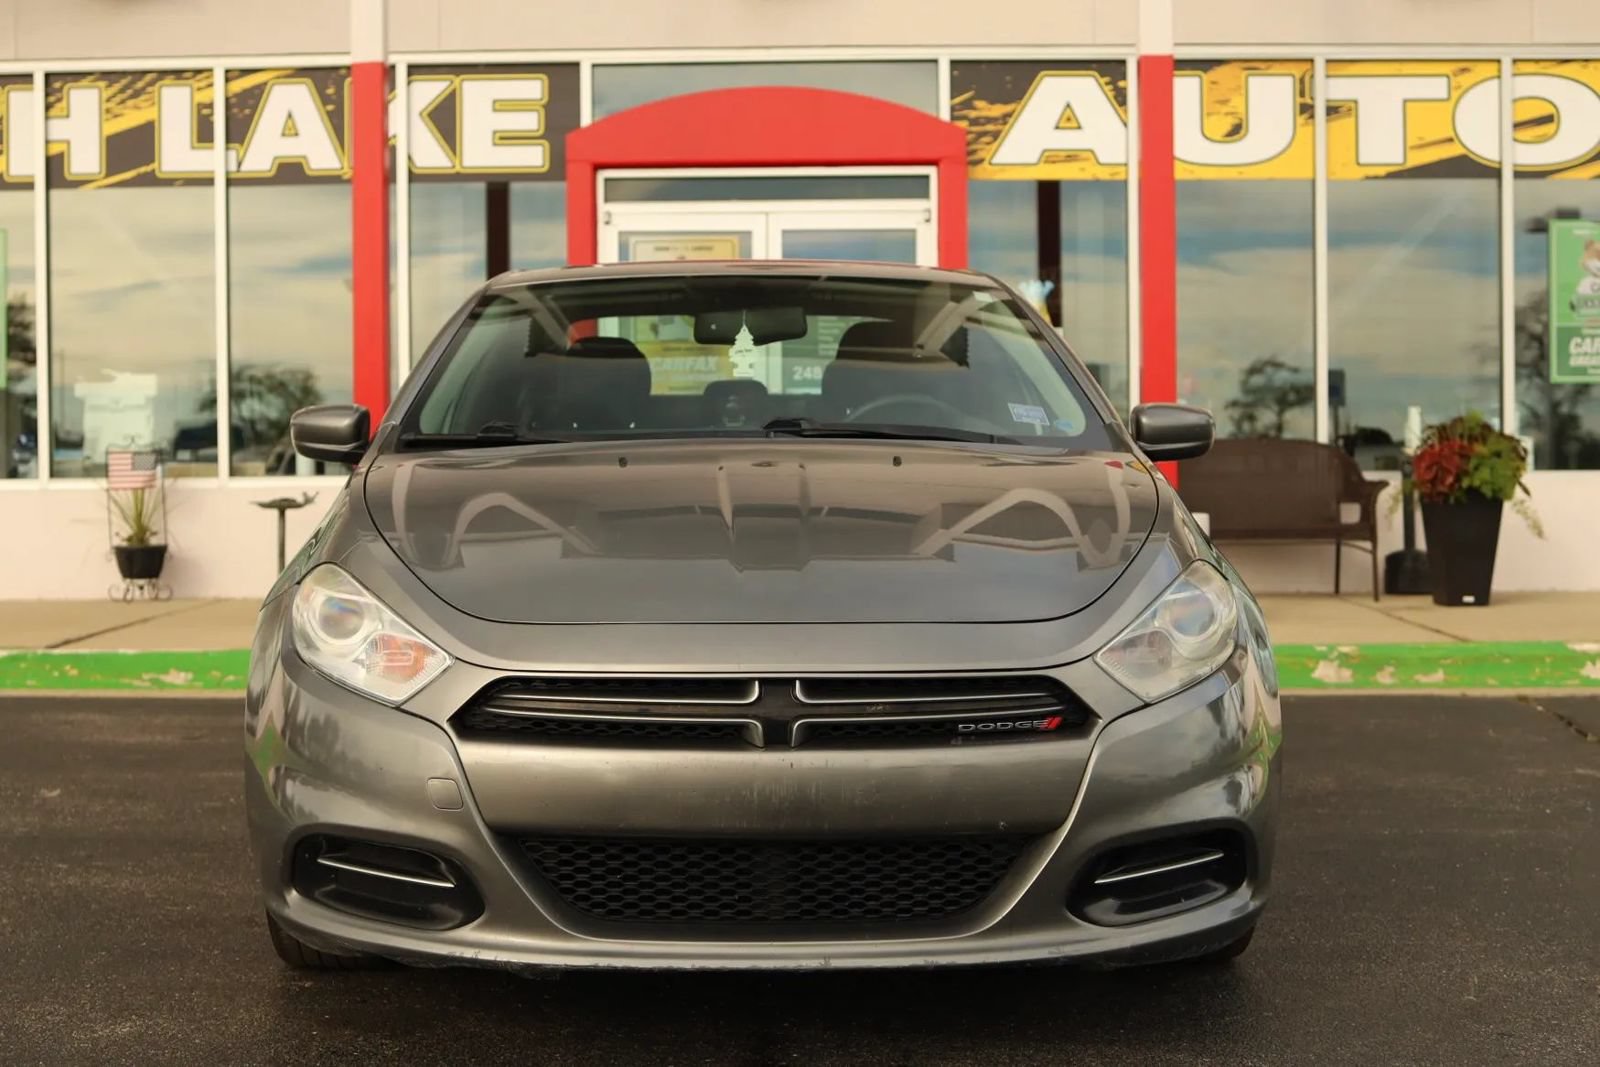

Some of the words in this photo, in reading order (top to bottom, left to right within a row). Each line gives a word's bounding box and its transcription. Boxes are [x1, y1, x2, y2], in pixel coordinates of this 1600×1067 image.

[155, 74, 549, 179] LAKE
[988, 71, 1600, 169] AUTO
[957, 719, 1049, 732] DODGE
